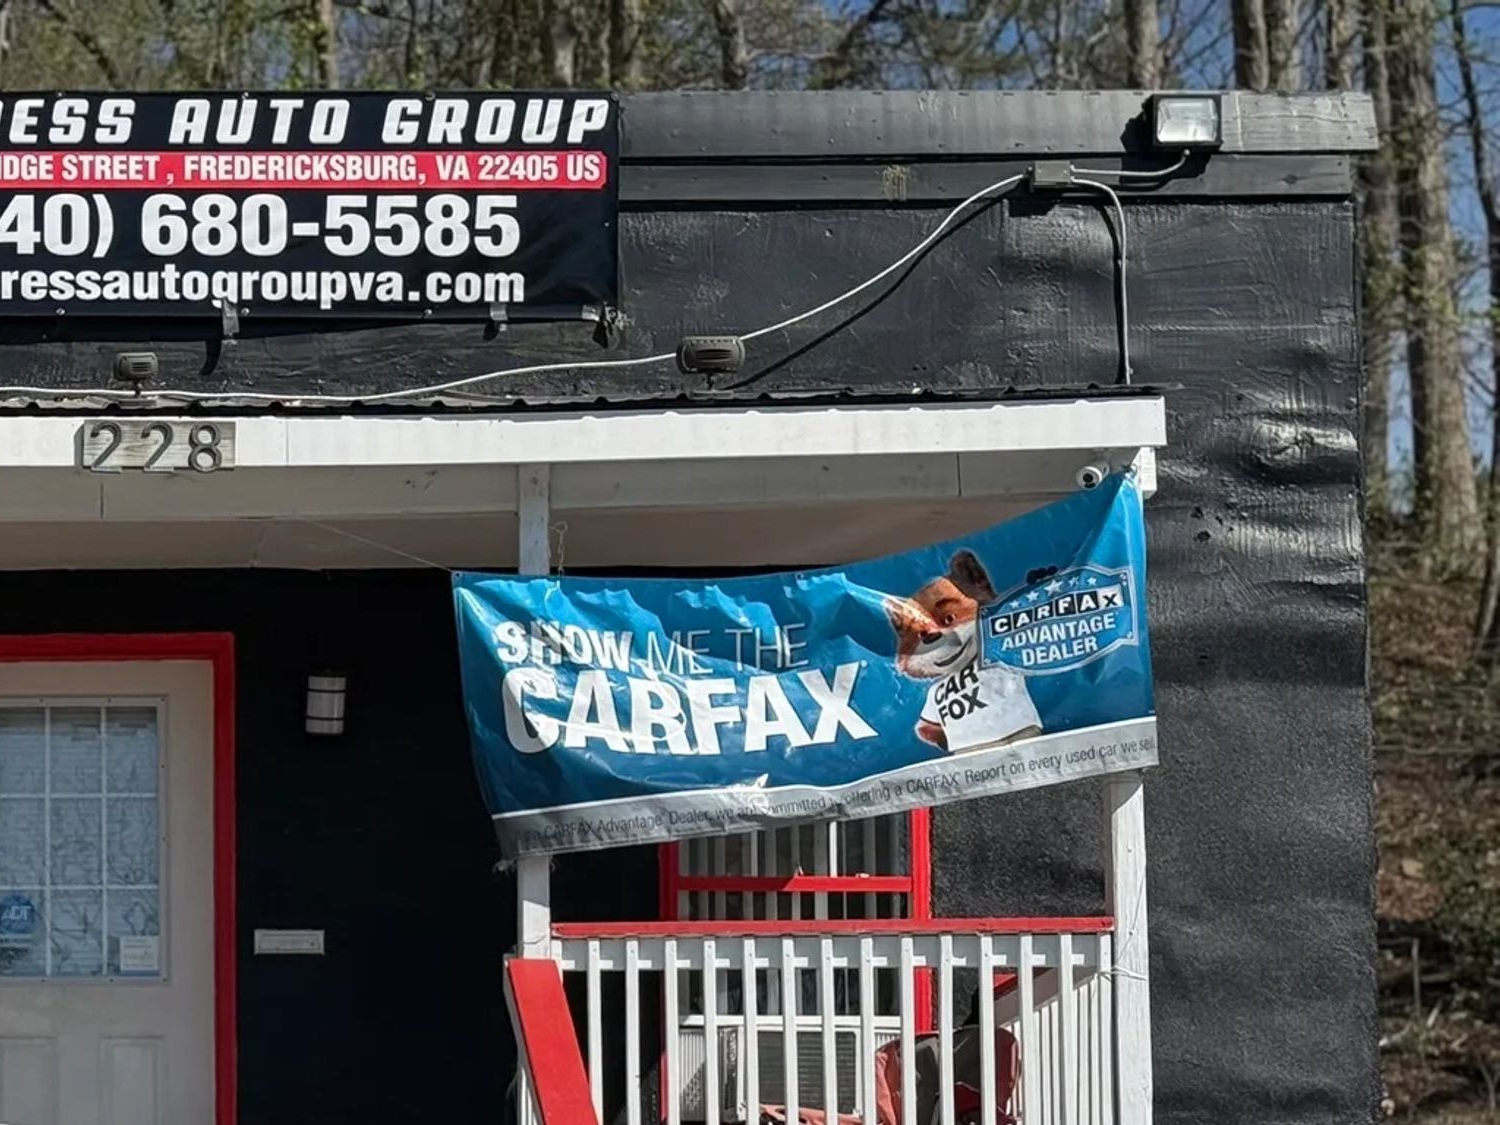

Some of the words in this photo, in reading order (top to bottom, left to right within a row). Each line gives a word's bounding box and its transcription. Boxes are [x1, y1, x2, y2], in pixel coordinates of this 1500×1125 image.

[168, 99, 350, 144] AUTO
[381, 99, 610, 144] GROUP
[62, 155, 160, 181] STREET
[184, 154, 426, 185] FREDERICKSBURG,
[438, 155, 471, 181] VA
[477, 155, 558, 181] 22405
[566, 155, 601, 180] US
[141, 193, 521, 257] 680-5585
[90, 421, 222, 474] 228
[992, 592, 1120, 635] CARFAX
[1000, 612, 1117, 652] ADVANTAGE
[496, 620, 634, 673] SHOW
[648, 628, 714, 676] ME
[724, 623, 809, 671] THE
[1021, 635, 1098, 667] DEALER
[934, 653, 980, 706] CAR
[502, 661, 880, 755] CARFAX
[938, 686, 989, 727] FOX
[963, 763, 1006, 785] Report
[1009, 761, 1025, 775] on
[1065, 744, 1096, 764] used
